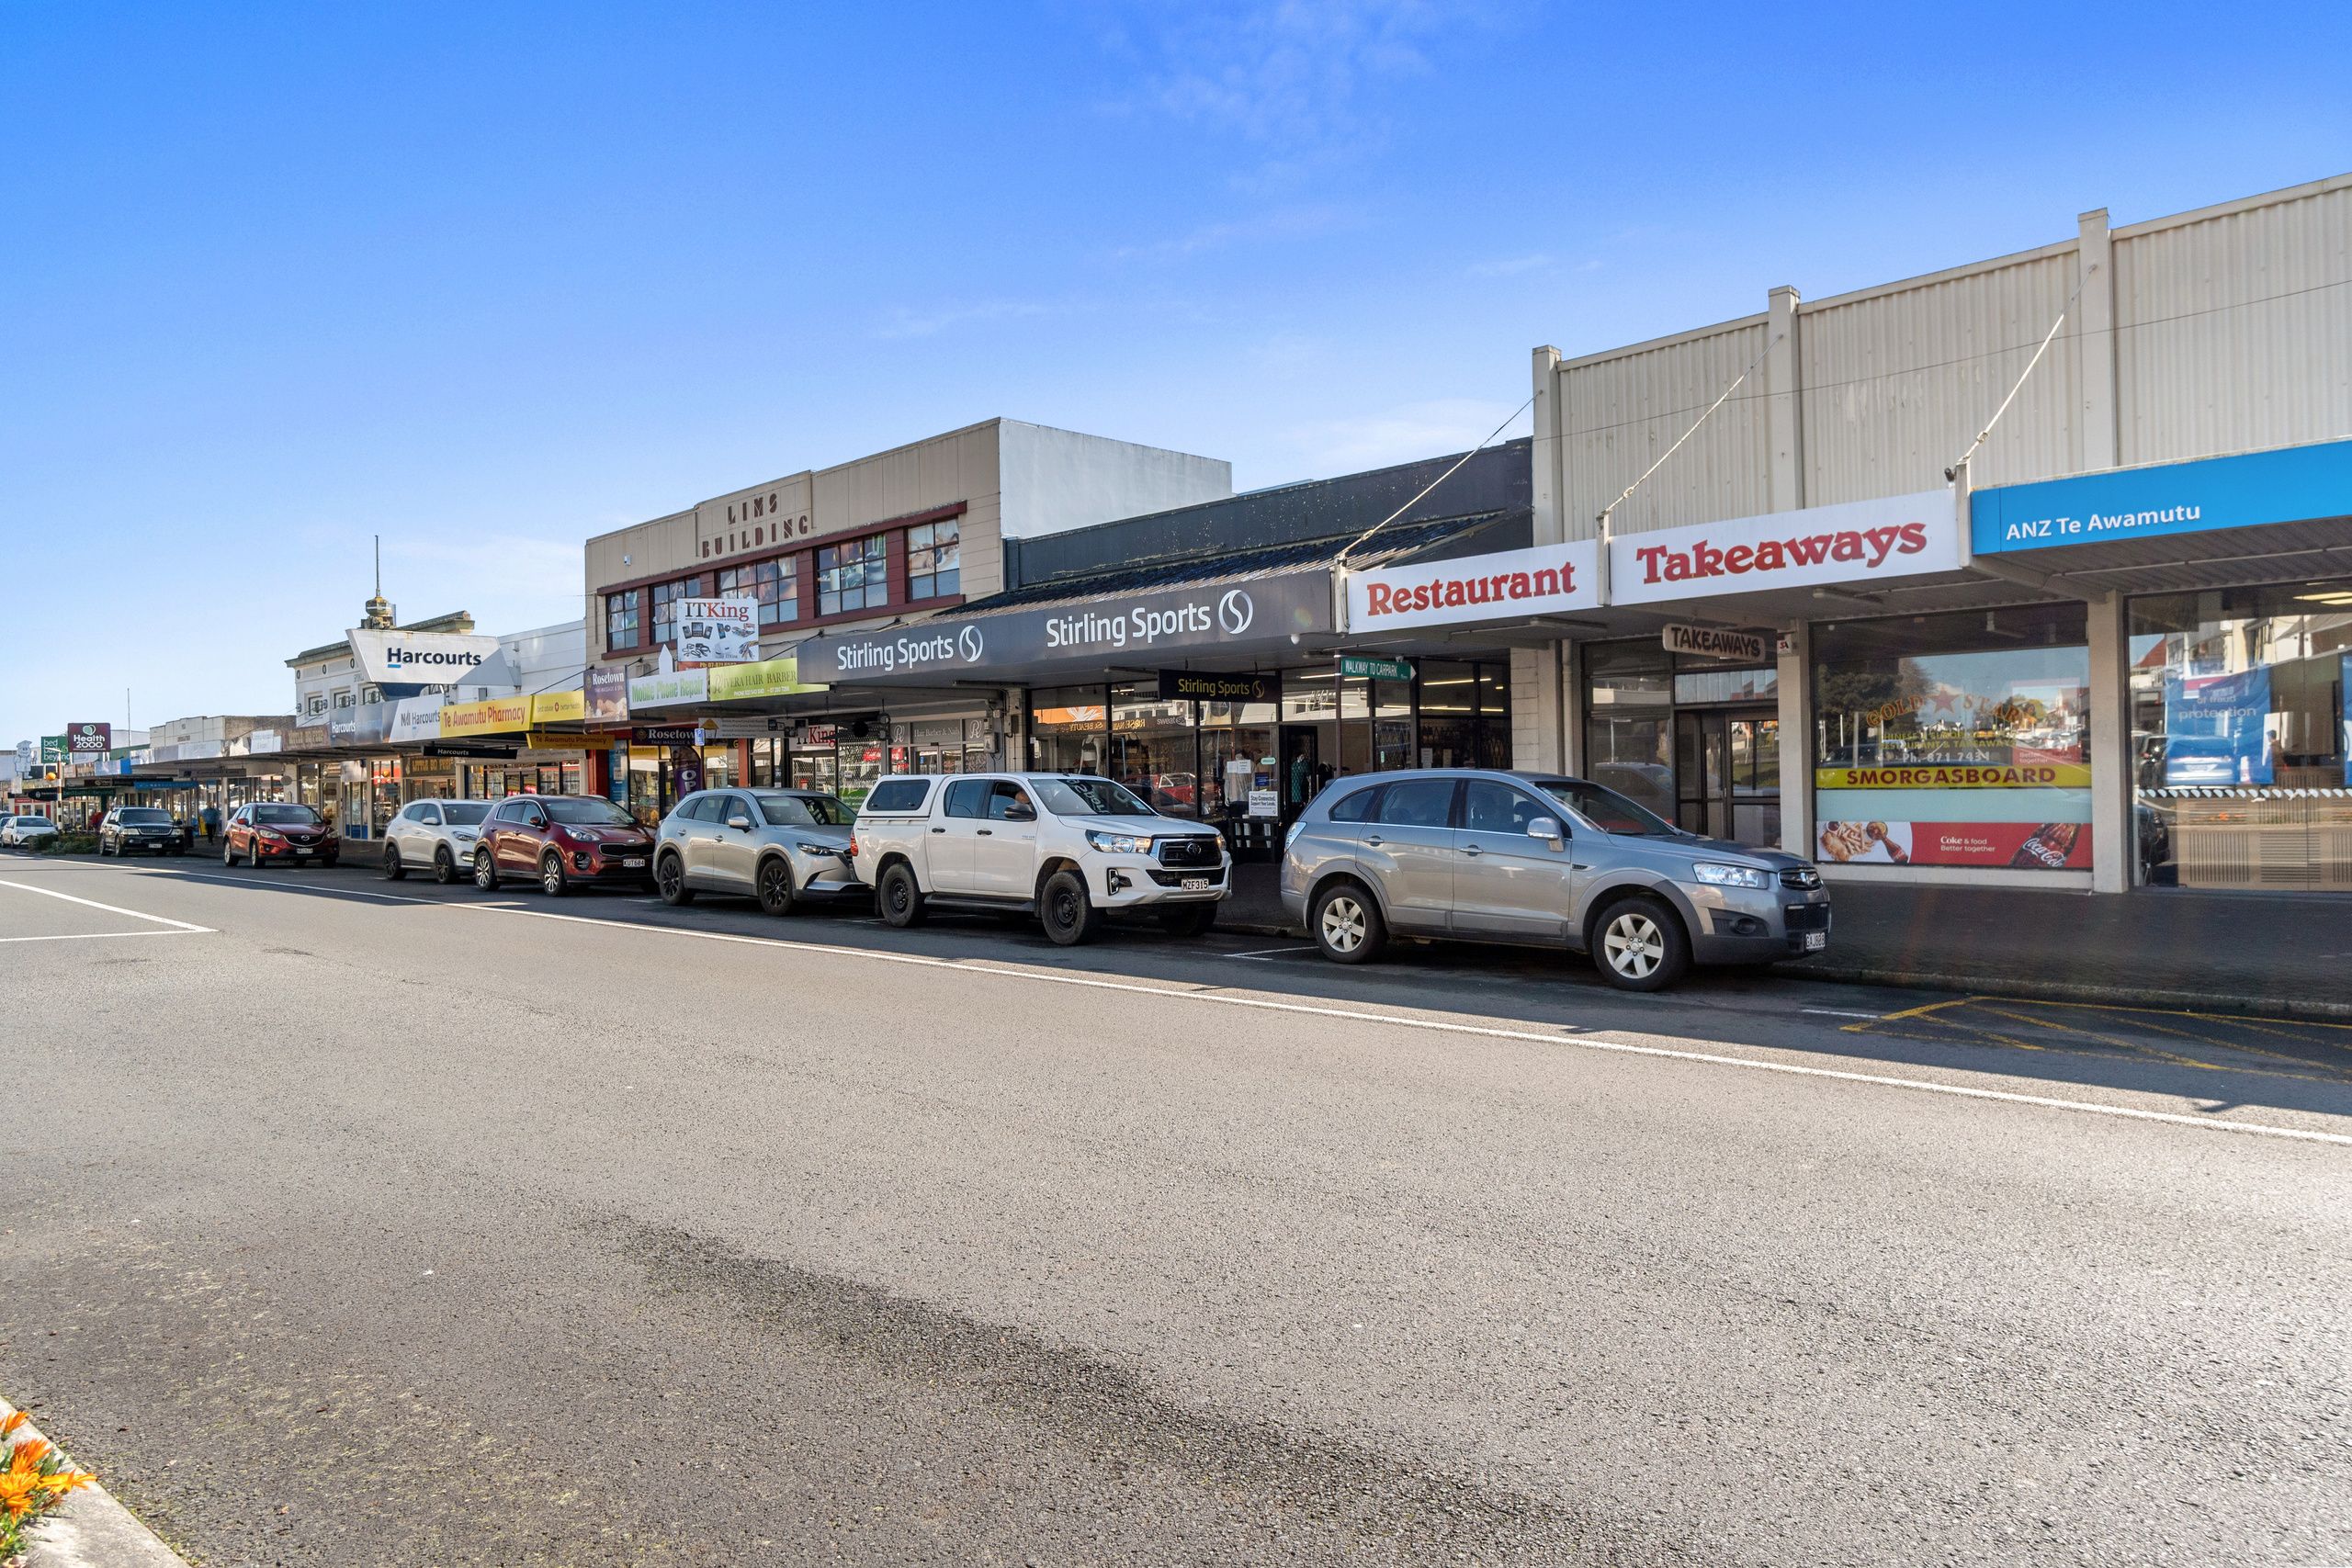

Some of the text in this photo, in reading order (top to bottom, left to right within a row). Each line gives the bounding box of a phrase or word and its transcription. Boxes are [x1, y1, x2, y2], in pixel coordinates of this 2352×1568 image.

[2006, 503, 2200, 540] ANZ Te Awamutu
[702, 514, 808, 559] BUILDING
[1636, 522, 1928, 584] Takeaways
[1366, 560, 1577, 617] Restaurant
[684, 602, 749, 622] ITKing
[1046, 602, 1211, 648] Stirling Sports
[1670, 626, 1761, 658] TAKEAWAYS
[387, 647, 482, 666] Harcourts
[837, 637, 954, 671] Stirling Sports
[1345, 660, 1397, 677] WALKWAY TO CARPARK
[593, 672, 625, 685] Rosetown
[745, 674, 763, 687] HAIR
[767, 671, 797, 684] BARBER
[1178, 678, 1250, 696] Stirling Sports
[632, 677, 704, 703] Mobile Phone Repair
[413, 710, 440, 726] Harcourts
[444, 705, 526, 728] Te Awamutu Pharmacy
[1866, 694, 2023, 728] GOLD STAR
[2179, 705, 2256, 722] protection
[332, 720, 356, 733] Harcourts
[648, 728, 695, 739] Rosetow
[43, 739, 58, 747] bed
[576, 737, 606, 745] Pharmacy
[437, 748, 469, 756] Harcourts
[1903, 751, 1921, 762] Ph.
[1928, 751, 1951, 762] 871
[1847, 766, 2056, 784] SMORGASBOARD
[1940, 836, 1962, 844] Coke
[1964, 845, 1996, 853] together
